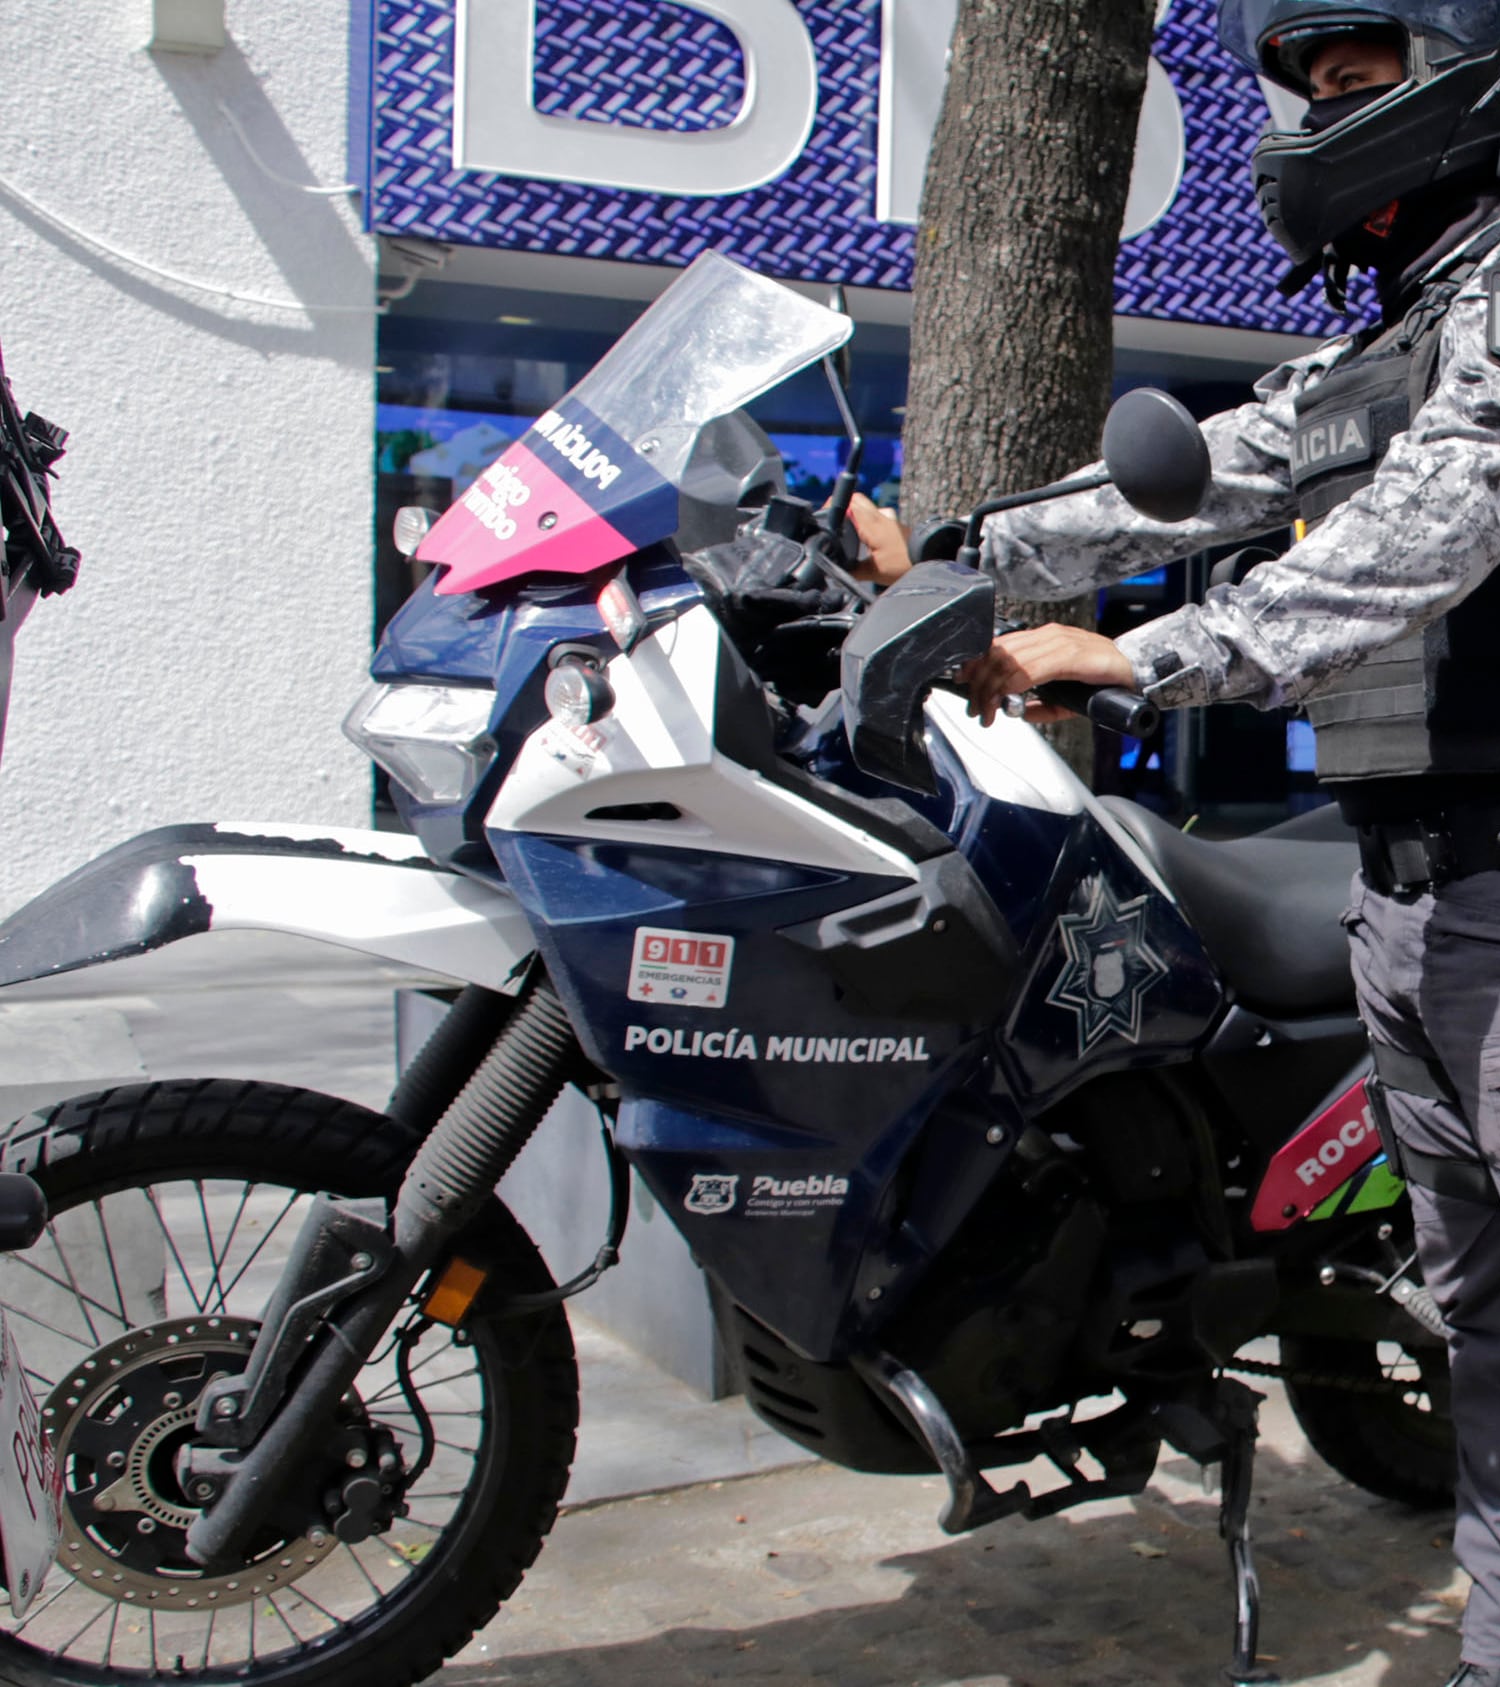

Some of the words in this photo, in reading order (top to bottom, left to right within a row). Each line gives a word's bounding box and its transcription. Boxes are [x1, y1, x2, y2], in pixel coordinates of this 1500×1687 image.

[1293, 418, 1366, 470] LICIA
[643, 936, 723, 967] 911
[638, 970, 722, 986] EMERGENCIAS
[624, 1025, 758, 1060] POLICÍA
[765, 1036, 930, 1063] MUNICIPAL
[751, 1174, 849, 1197] Puebla
